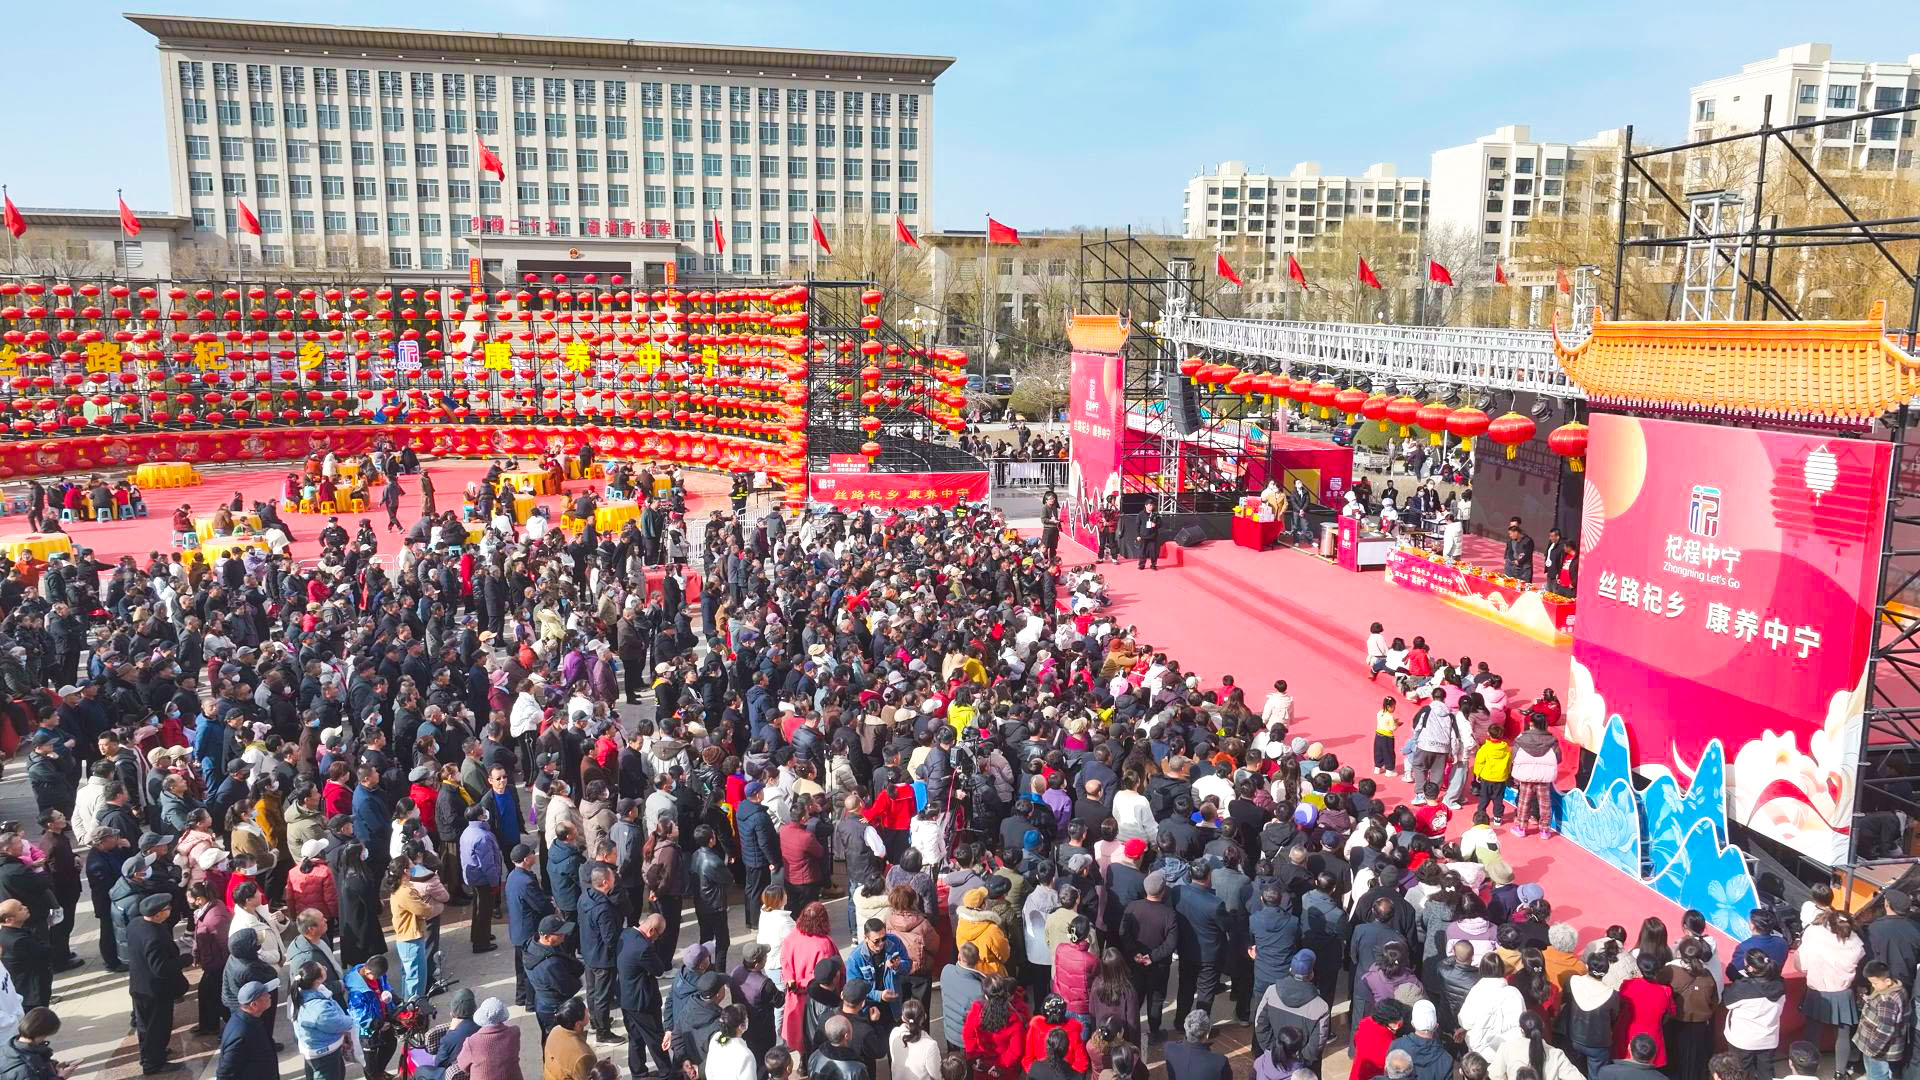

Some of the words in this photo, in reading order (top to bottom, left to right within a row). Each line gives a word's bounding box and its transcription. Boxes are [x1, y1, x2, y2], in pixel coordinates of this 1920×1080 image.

[484, 342, 719, 378] 康养中宁
[833, 489, 899, 501] 丝路杞乡
[907, 488, 970, 500] 康养中宁
[1664, 534, 1742, 574] 杞程中宁
[1663, 561, 1705, 583] Zhongning
[1706, 572, 1727, 585] Let's
[1727, 577, 1741, 589] Go
[1597, 570, 1687, 620] 丝路杞乡
[1705, 602, 1821, 660] 康养中宁
